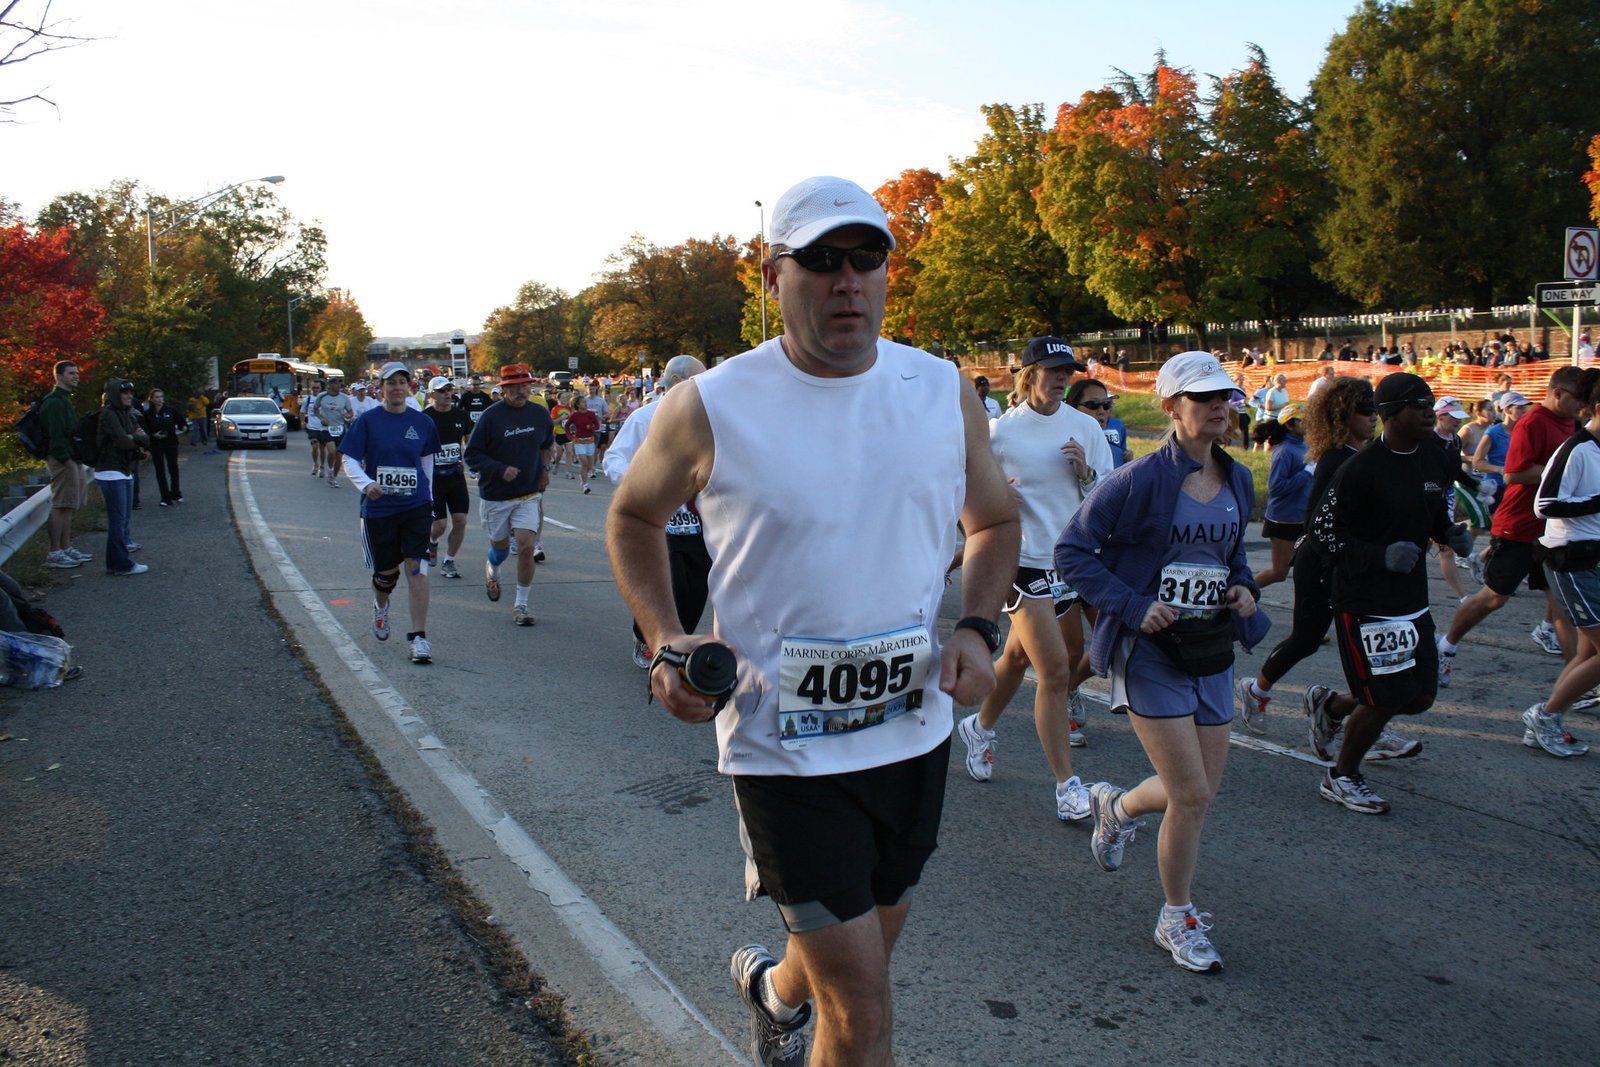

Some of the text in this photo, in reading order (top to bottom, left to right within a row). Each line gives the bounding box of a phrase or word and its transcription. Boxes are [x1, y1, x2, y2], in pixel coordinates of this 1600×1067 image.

[1544, 289, 1593, 300] ONE WAY
[377, 472, 417, 488] 18496
[667, 511, 698, 526] 9398
[1159, 577, 1228, 606] 31226
[783, 633, 928, 660] MARINE CORPS MARATHON
[1363, 628, 1416, 653] 12341
[797, 653, 914, 704] 4095
[800, 725, 819, 733] USAA
